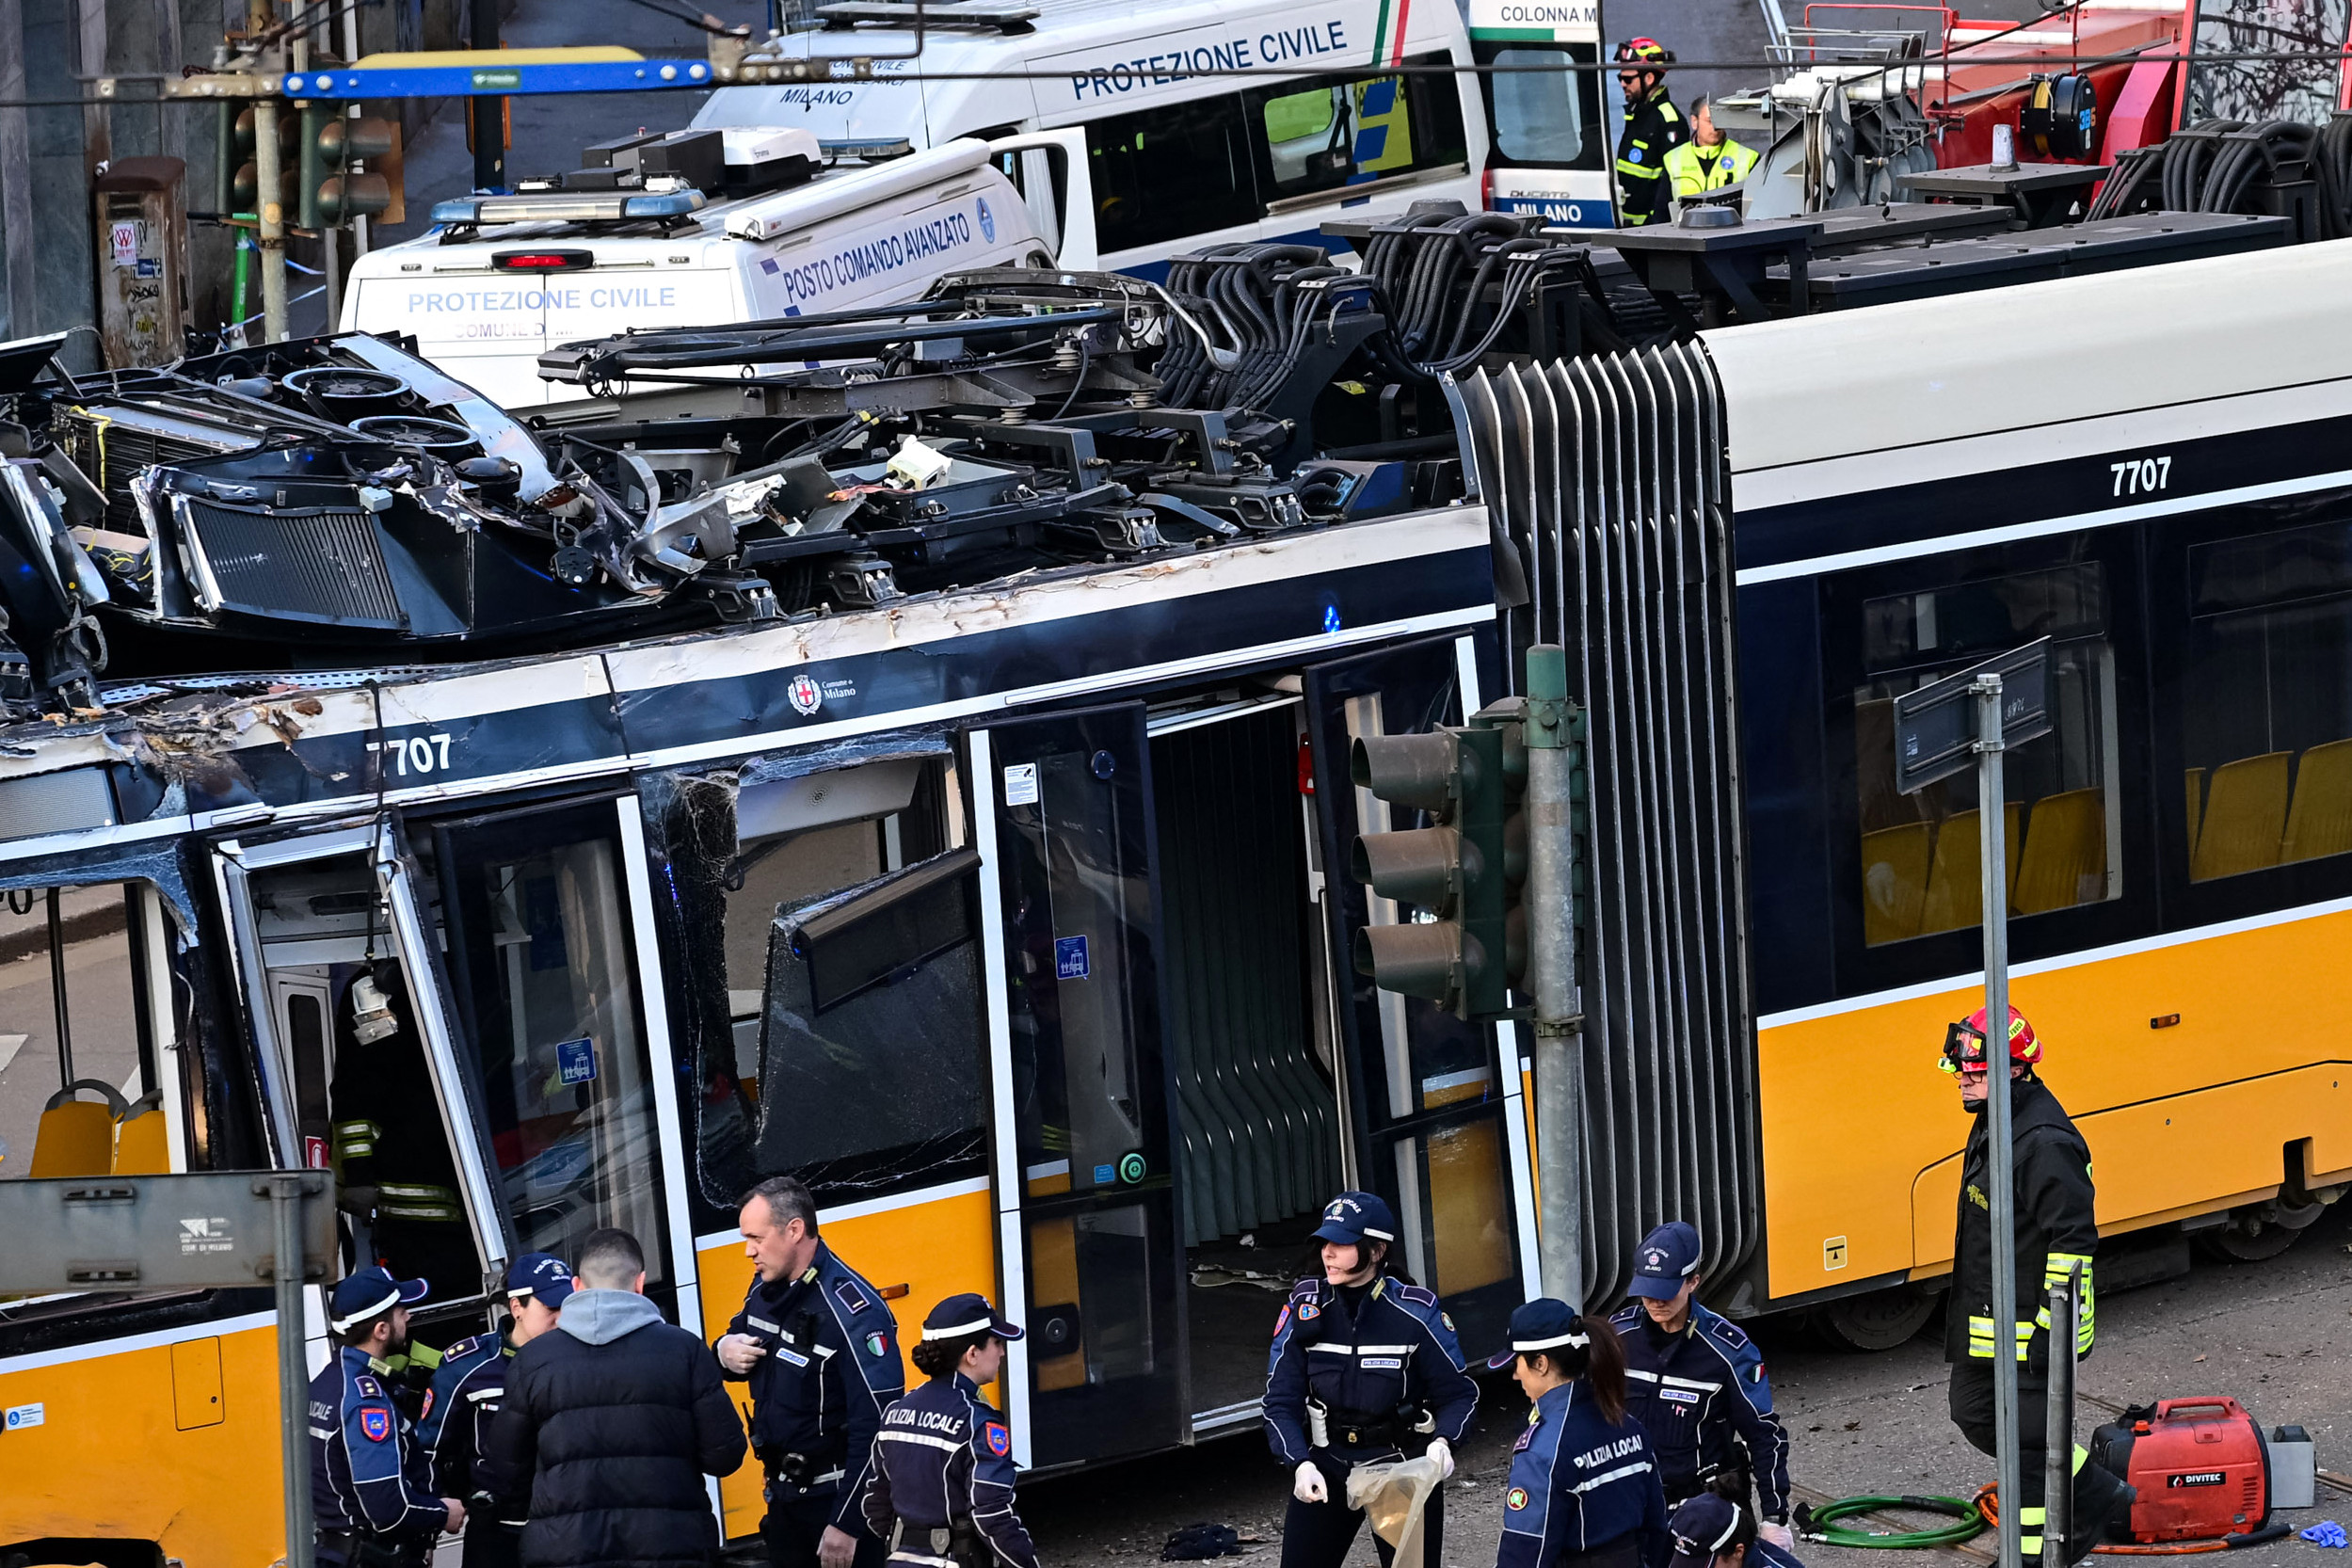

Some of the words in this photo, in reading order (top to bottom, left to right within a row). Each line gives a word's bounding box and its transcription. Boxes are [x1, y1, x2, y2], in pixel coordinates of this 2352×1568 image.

[1500, 6, 1580, 23] COLONNA
[1070, 39, 1254, 101] PROTEZIONE
[1258, 20, 1348, 63] CIVILE
[779, 88, 854, 105] MILANO
[1509, 190, 1570, 200] DUCATO
[783, 259, 834, 304] POSTO
[833, 235, 904, 285] COMANDO
[904, 212, 970, 264] AVANZATO
[408, 290, 582, 312] PROTEZIONE
[590, 287, 676, 309] CIVILE
[2110, 456, 2172, 498] 7707
[824, 688, 856, 700] Milano
[917, 1410, 965, 1435] LOCALE
[1573, 1443, 1614, 1470] POLIZIA
[2185, 1473, 2222, 1484] DIVITEC
